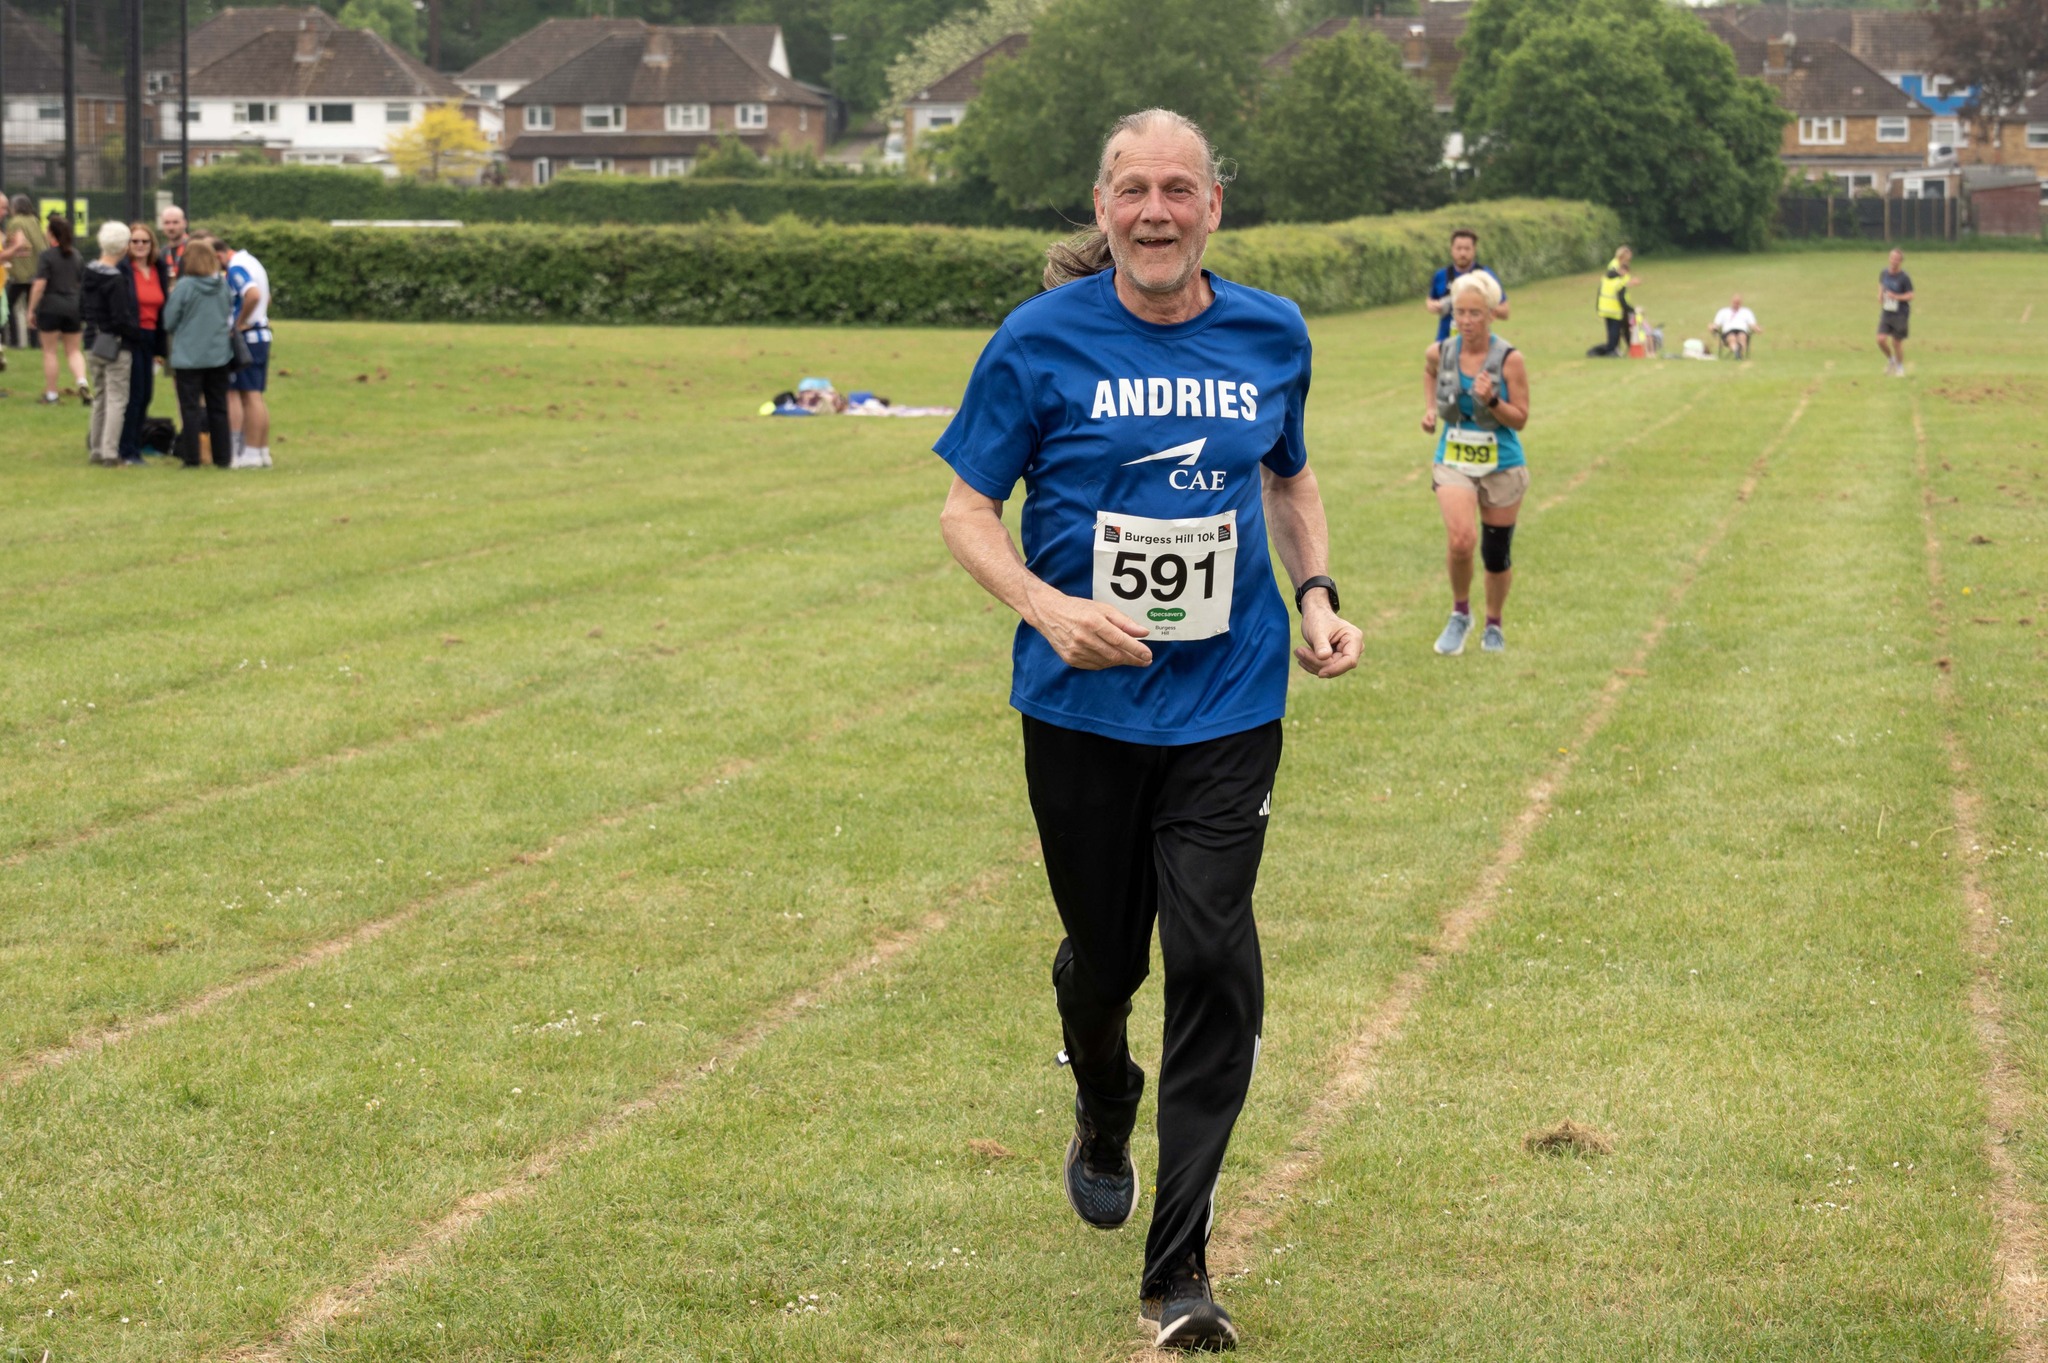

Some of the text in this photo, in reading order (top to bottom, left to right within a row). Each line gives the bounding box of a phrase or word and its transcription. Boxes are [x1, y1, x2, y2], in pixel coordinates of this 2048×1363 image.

[1091, 377, 1259, 422] ANDRIES
[1453, 443, 1490, 463] 199
[1168, 469, 1227, 491] CAE
[1124, 531, 1172, 545] Burgess
[1175, 533, 1194, 544] Hill
[1197, 531, 1215, 543] 10k
[1110, 551, 1216, 602] 591
